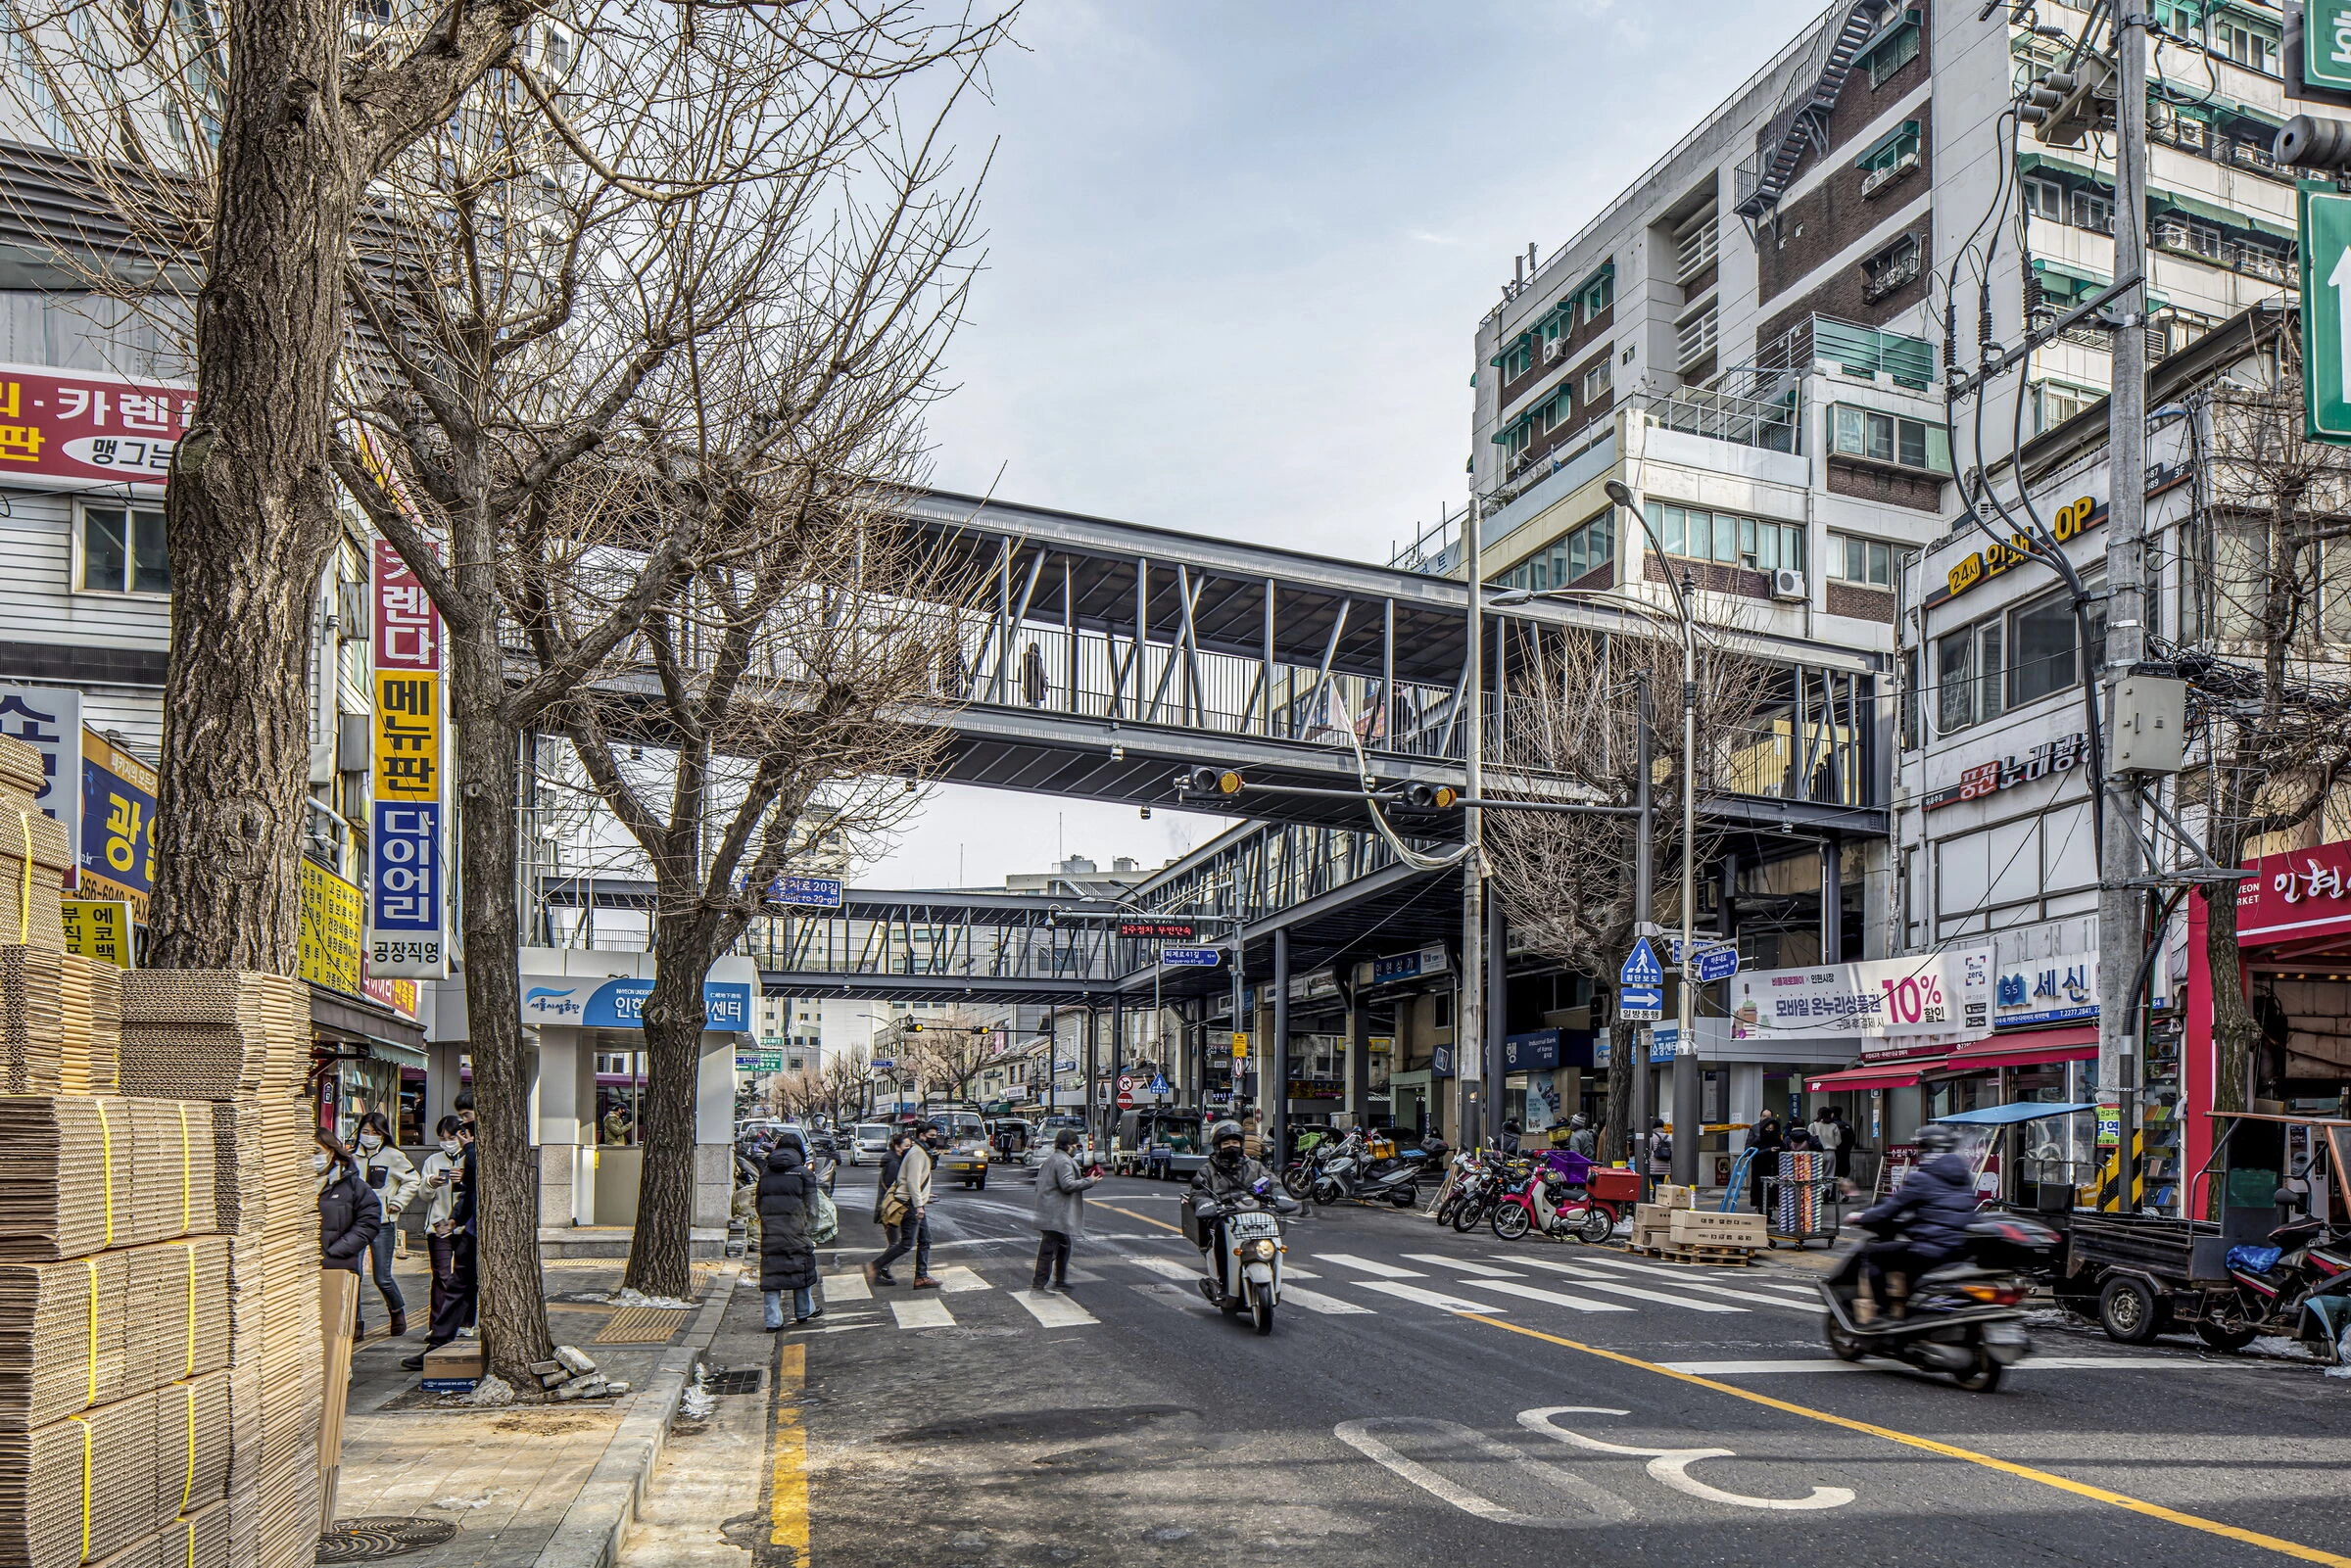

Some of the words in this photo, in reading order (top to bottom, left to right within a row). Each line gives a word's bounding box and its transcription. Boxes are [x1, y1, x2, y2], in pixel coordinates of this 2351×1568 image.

[2175, 465, 2184, 479] 3F
[1951, 562, 1979, 589] 24시
[2055, 497, 2094, 541] OP
[383, 680, 435, 792] 메뉴판
[382, 810, 436, 924] 다이어리
[2274, 858, 2351, 904] 인현
[1158, 926, 1192, 935] 무인단속
[373, 941, 439, 965] 공장직영
[1375, 958, 1415, 977] 인현상가
[1626, 974, 1658, 982] 횡단보도
[530, 997, 581, 1016] 서울시설공단
[1776, 999, 1809, 1017] 모바일
[1811, 994, 1882, 1017] 온누리상품권
[1882, 974, 1943, 1024] 10%
[1622, 1009, 1659, 1020] 일방통행
[1923, 1006, 1944, 1022] 할인
